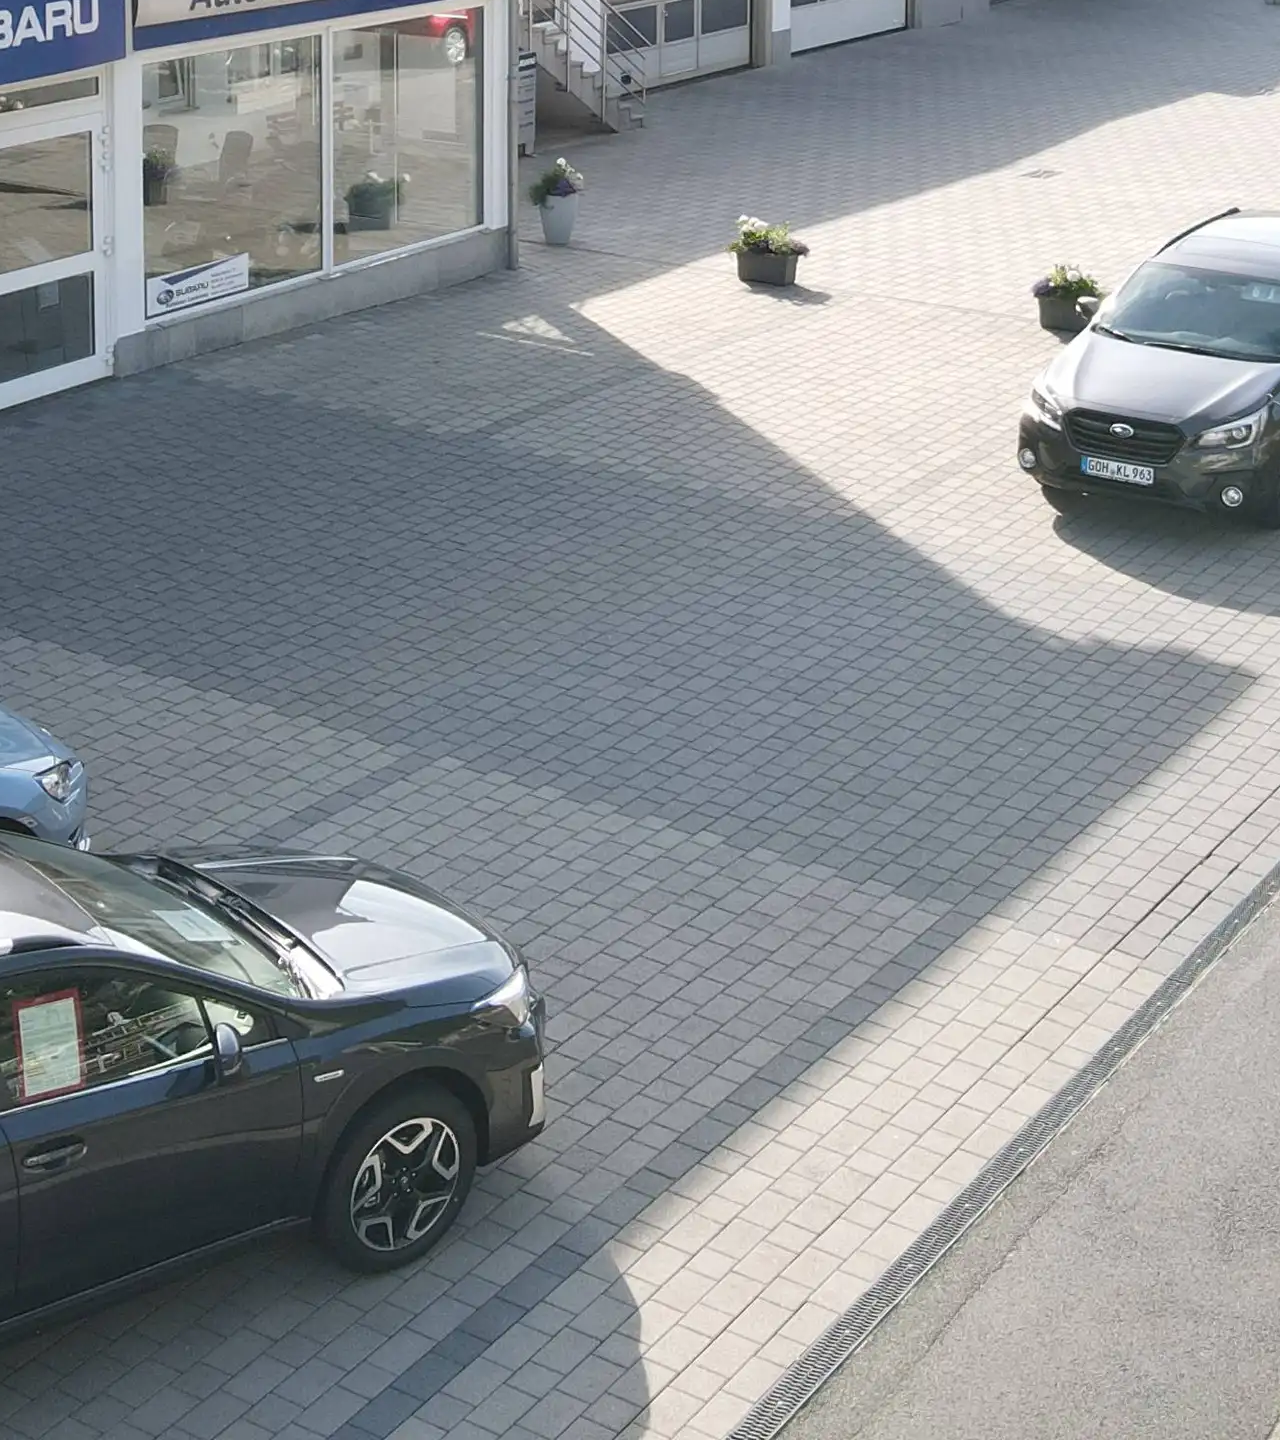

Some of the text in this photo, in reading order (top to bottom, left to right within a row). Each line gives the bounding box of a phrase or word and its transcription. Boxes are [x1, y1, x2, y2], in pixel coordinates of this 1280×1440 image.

[1088, 459, 1152, 482] GOH KL 963
